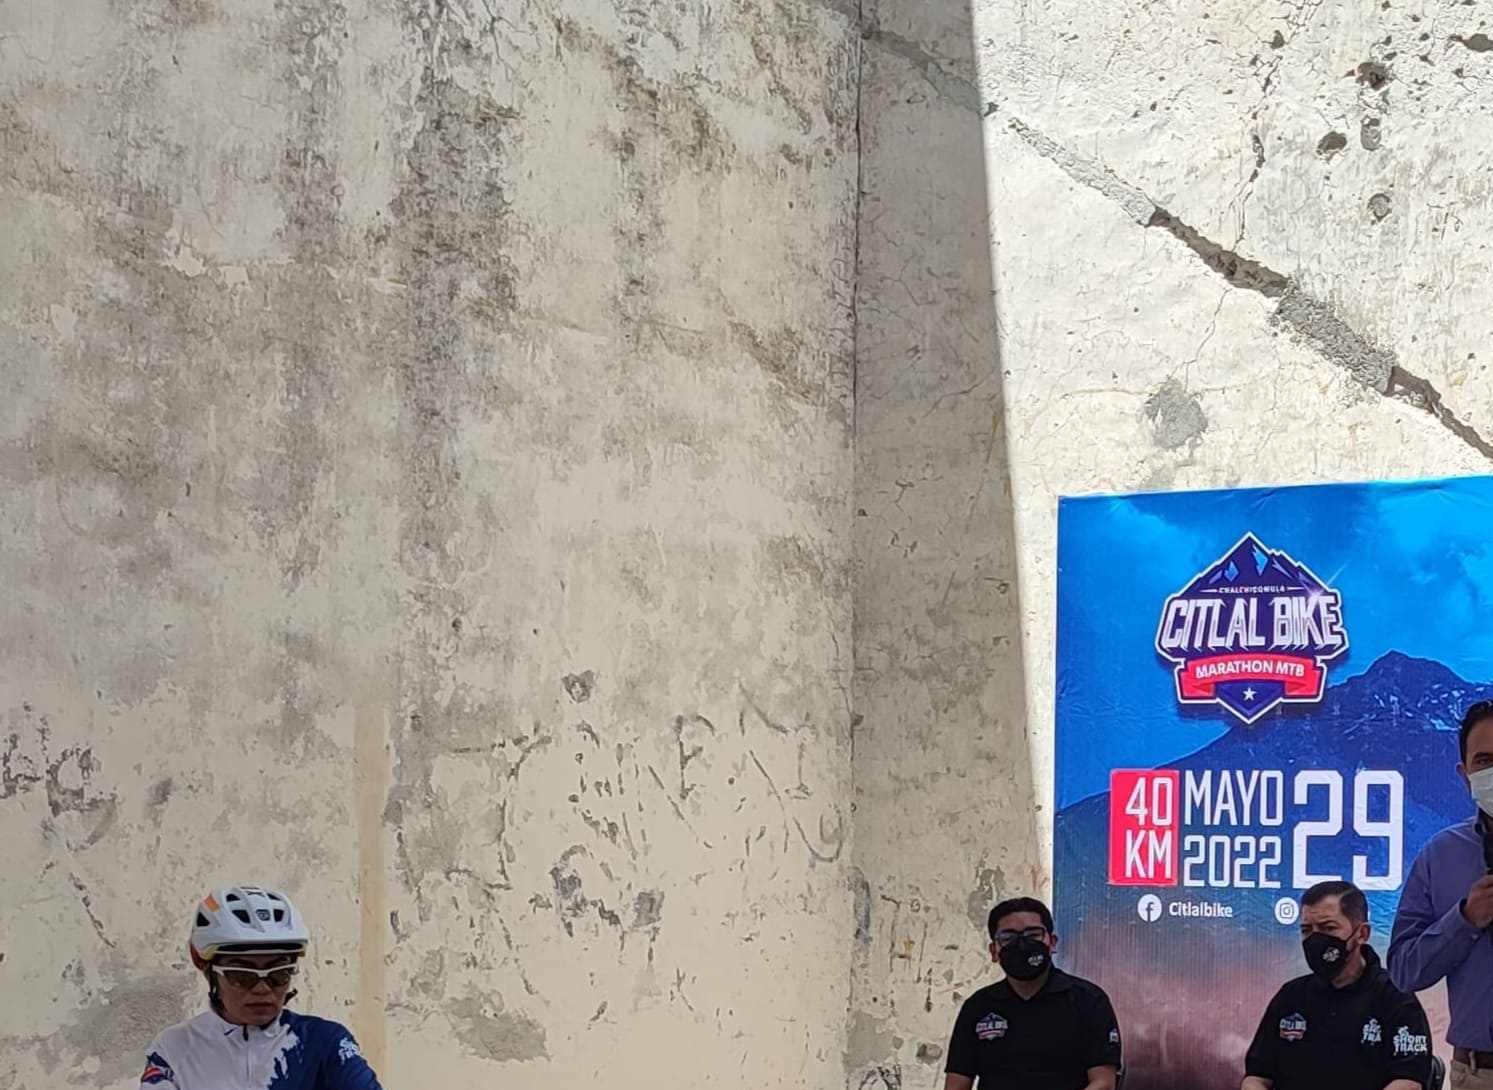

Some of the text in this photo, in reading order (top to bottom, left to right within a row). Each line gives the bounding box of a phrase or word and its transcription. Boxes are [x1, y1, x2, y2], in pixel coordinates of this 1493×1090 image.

[1161, 595, 1344, 650] CITLAL BIKE
[1195, 660, 1305, 679] MARATHON MTB
[1126, 777, 1174, 827] 40
[1125, 829, 1173, 880] KM
[1184, 769, 1405, 892] MAYO 29
[1183, 835, 1282, 889] 2022
[1168, 901, 1234, 919] Citlalbike
